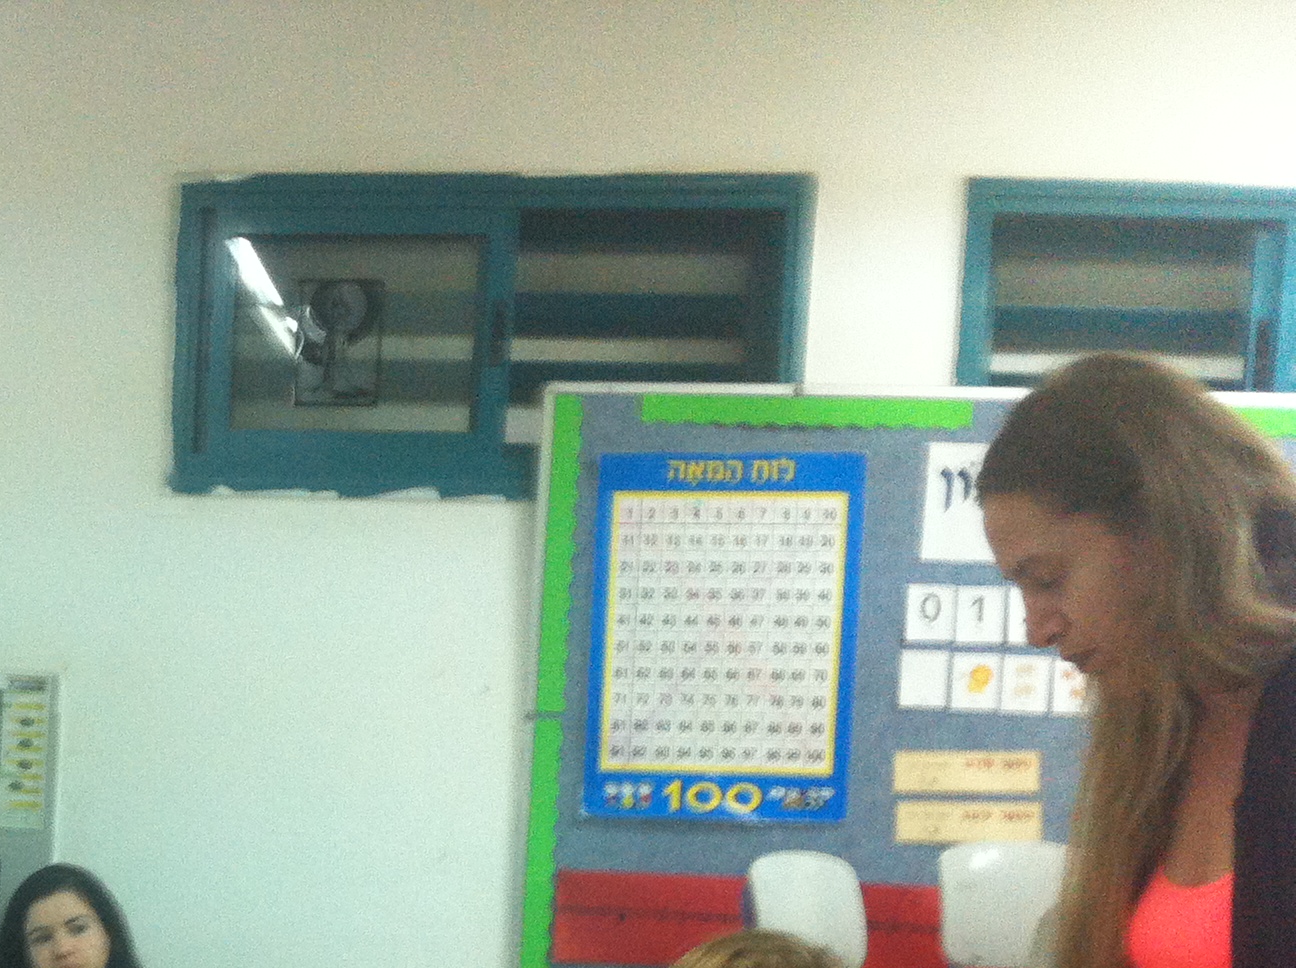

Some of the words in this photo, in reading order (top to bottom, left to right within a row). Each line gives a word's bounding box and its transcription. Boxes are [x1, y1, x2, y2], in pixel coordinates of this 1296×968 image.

[666, 459, 744, 484] המאה
[751, 458, 796, 482] לוח
[939, 465, 973, 514] ון
[920, 591, 942, 623] 0
[969, 595, 985, 623] 1
[663, 779, 764, 814] 100
